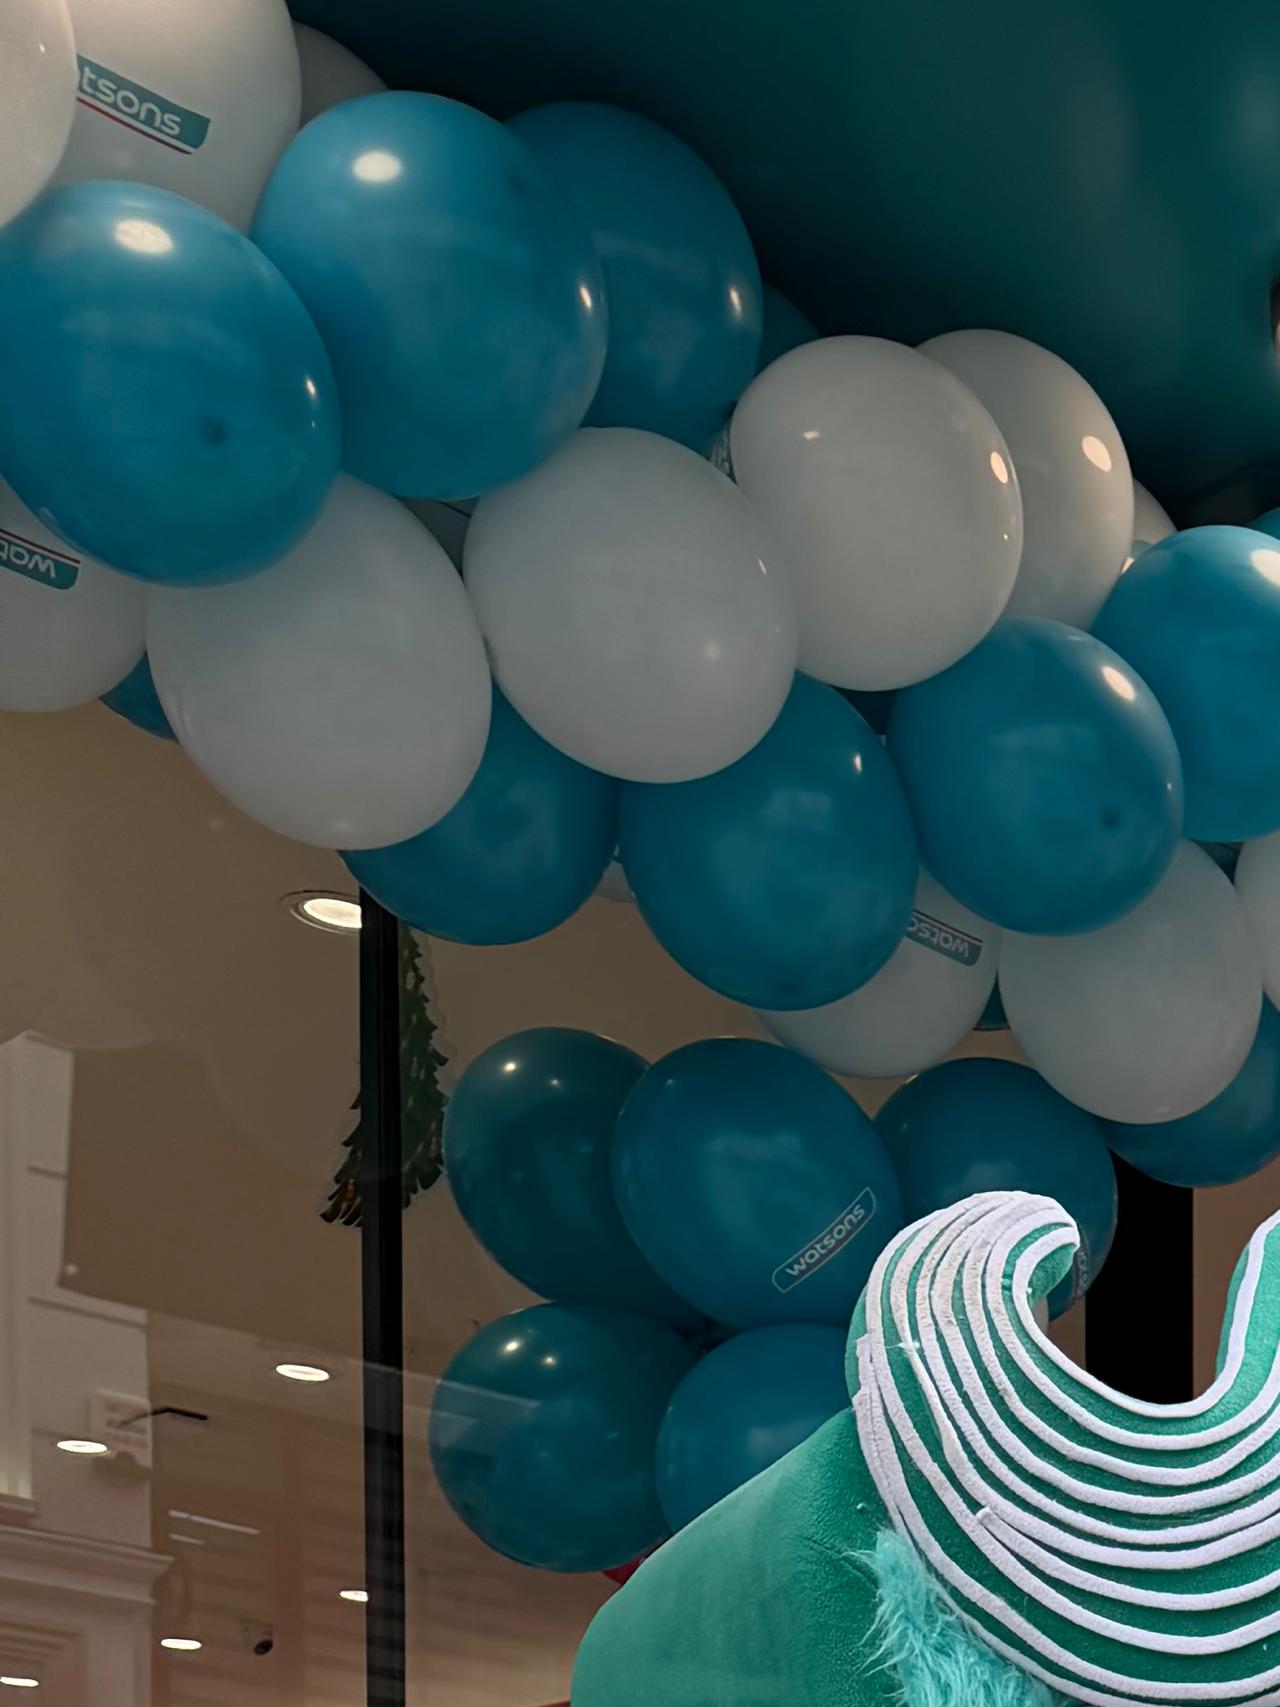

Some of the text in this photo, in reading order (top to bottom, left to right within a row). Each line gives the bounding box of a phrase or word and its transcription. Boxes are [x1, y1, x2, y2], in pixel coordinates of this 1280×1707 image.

[82, 65, 182, 136] tsons
[907, 918, 969, 957] watso
[785, 1204, 865, 1276] watsons
